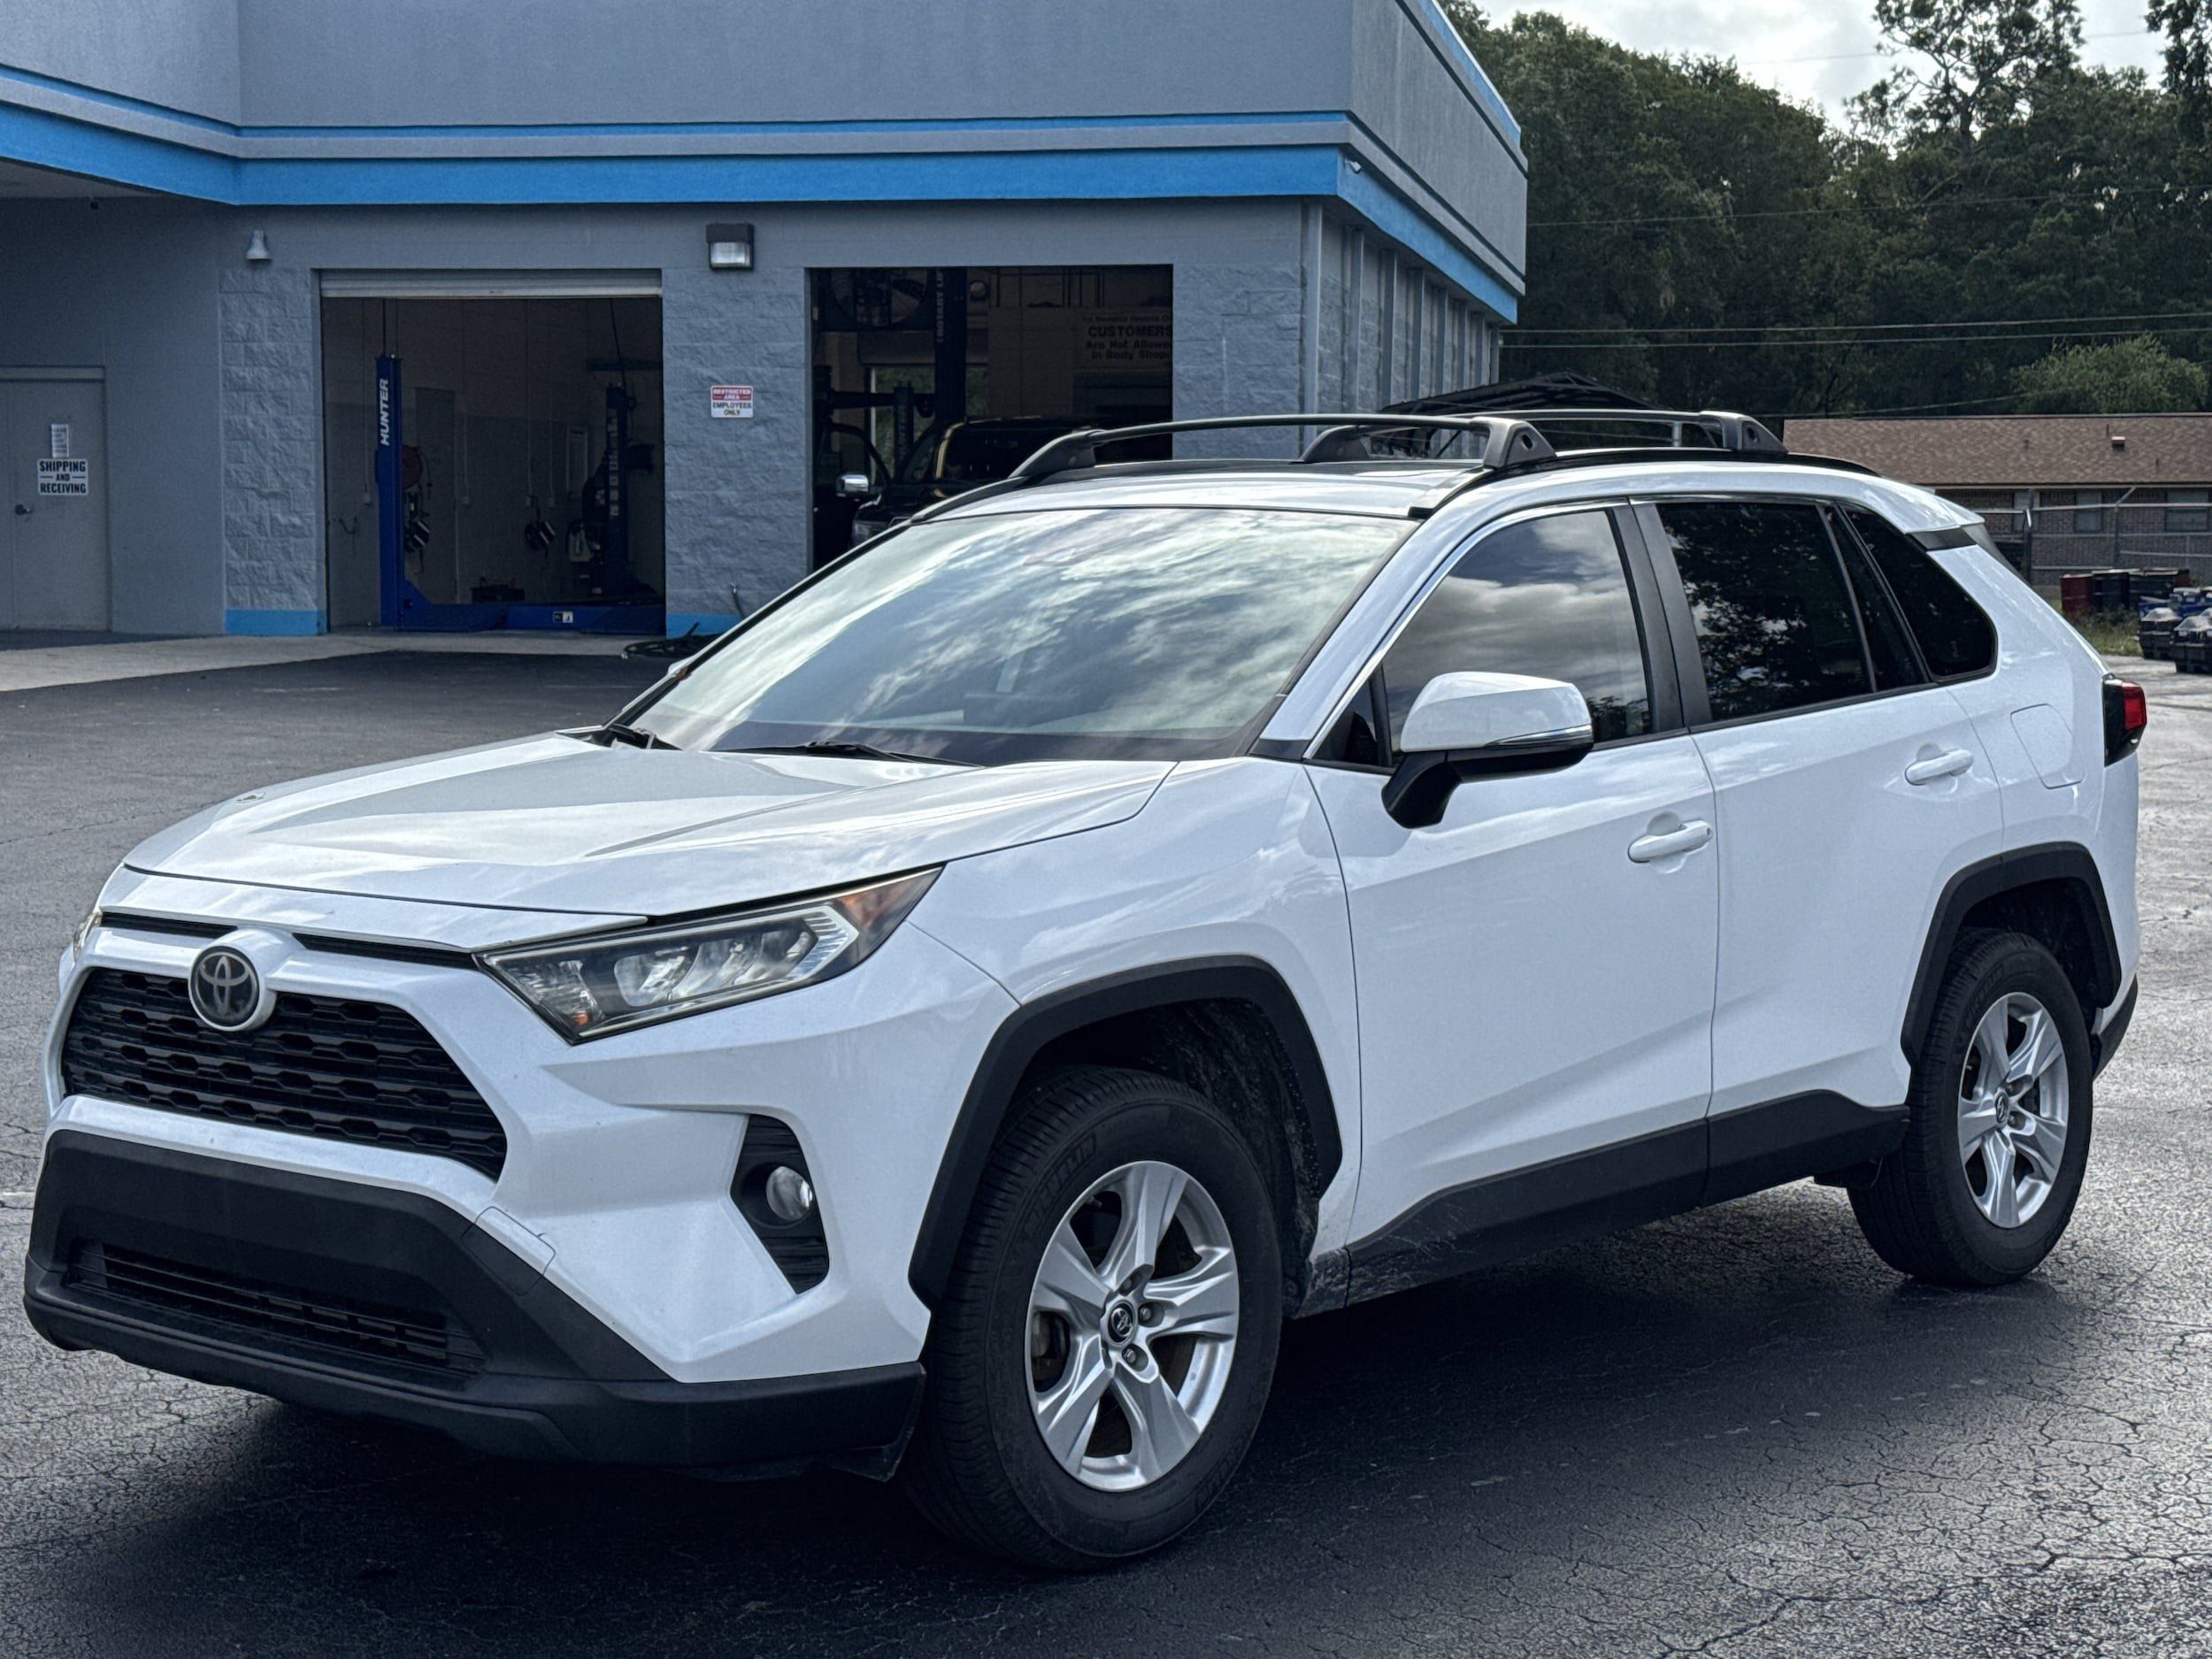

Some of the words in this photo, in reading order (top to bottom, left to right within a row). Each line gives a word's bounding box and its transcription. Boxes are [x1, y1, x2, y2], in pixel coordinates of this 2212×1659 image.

[1088, 325, 1171, 337] CUSTOMERS
[1110, 340, 1128, 349] Not
[1133, 340, 1171, 349] Allowe
[1106, 349, 1134, 360] Body
[380, 378, 389, 446] HUNTER
[39, 461, 86, 472] SHIPPING
[40, 483, 87, 494] RECEIVING
